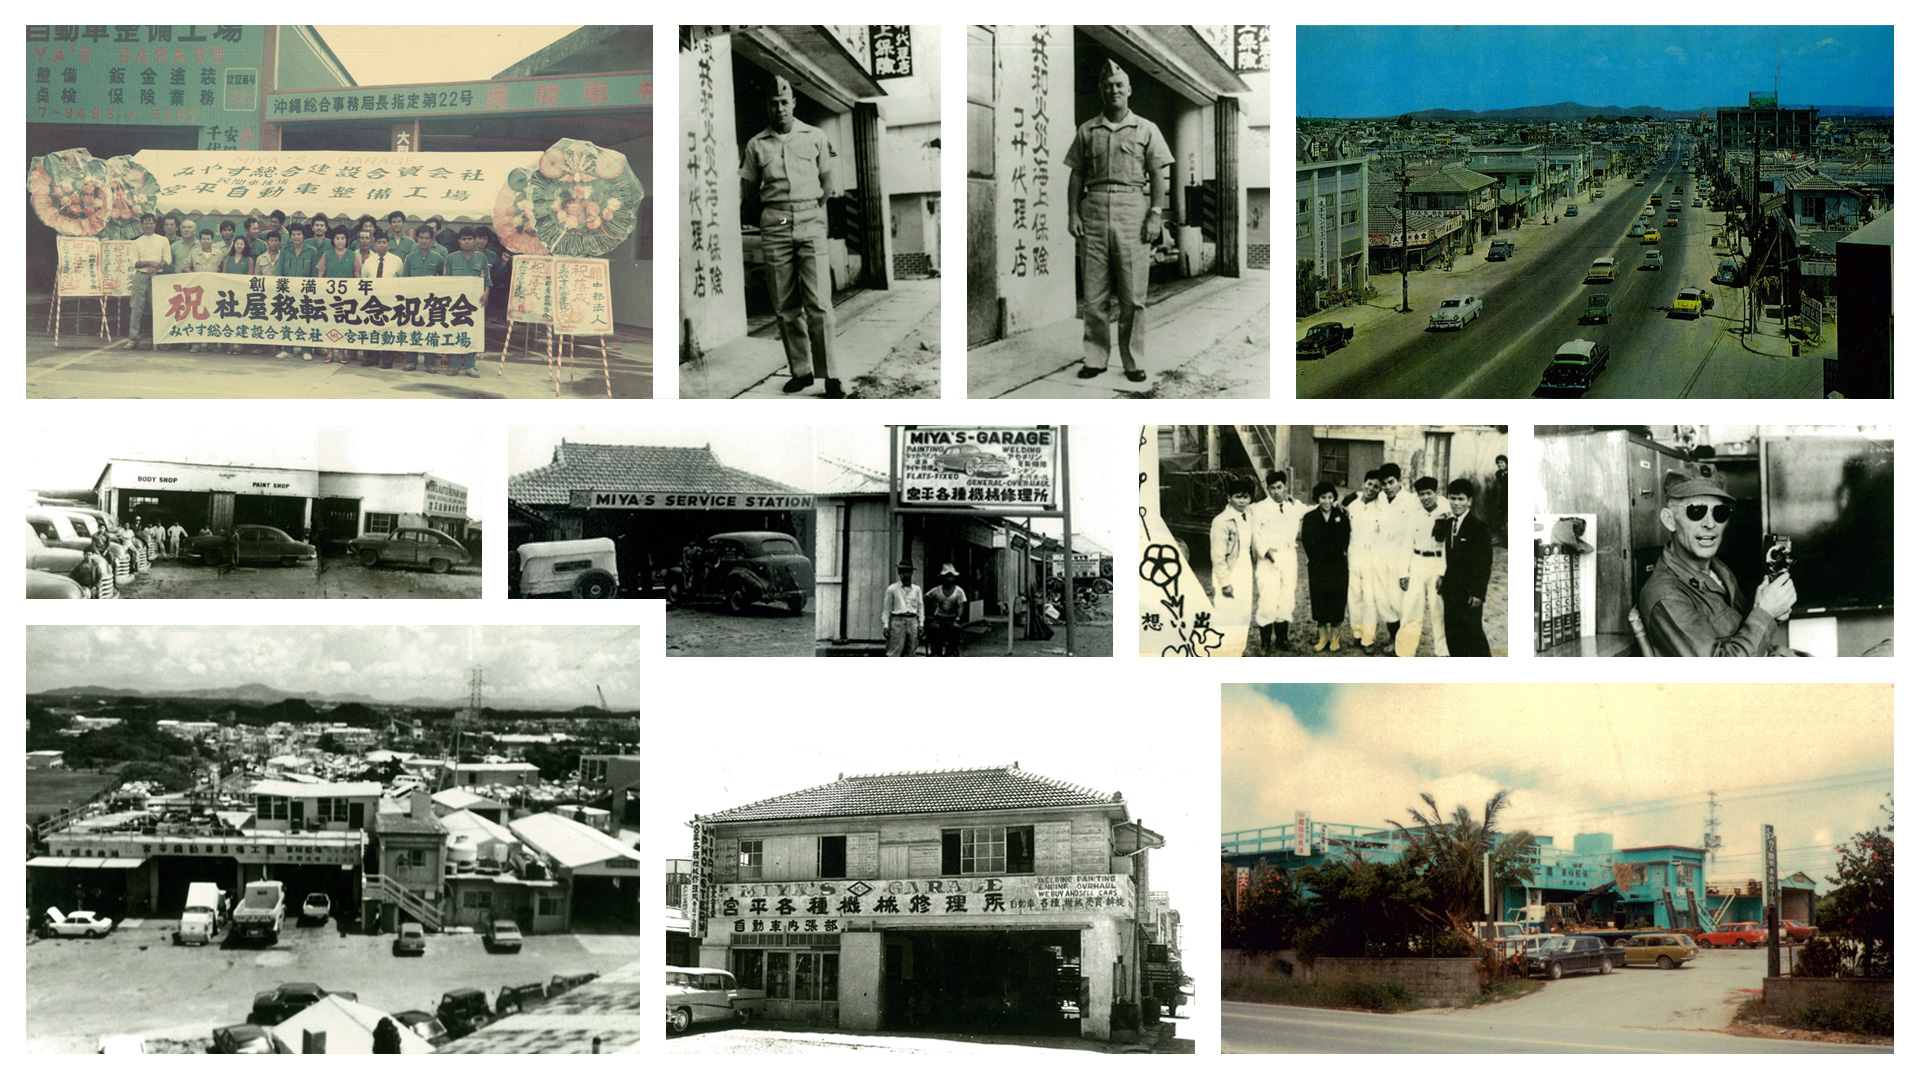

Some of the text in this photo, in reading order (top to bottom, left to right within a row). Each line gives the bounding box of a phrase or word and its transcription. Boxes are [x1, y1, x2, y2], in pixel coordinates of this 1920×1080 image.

[34, 45, 225, 63] YA'S GARAGE
[36, 67, 78, 84] 整備
[230, 89, 251, 103] 90
[152, 108, 197, 122] 5949
[338, 156, 413, 165] GARAGE
[173, 163, 485, 181] みやす総合建設合資会社
[161, 182, 471, 201] 宮平自動車整備工場
[165, 284, 478, 329] 祝 社屋移転記念祝賀会
[169, 323, 323, 343] みやす総合建設合資会社
[344, 329, 472, 348] 宮平自動車整備工場
[596, 493, 812, 509] MIYA'S SERVICE STATION
[723, 892, 1006, 916] 宮平各種機械修理所
[733, 919, 838, 932] 自動車内張部
